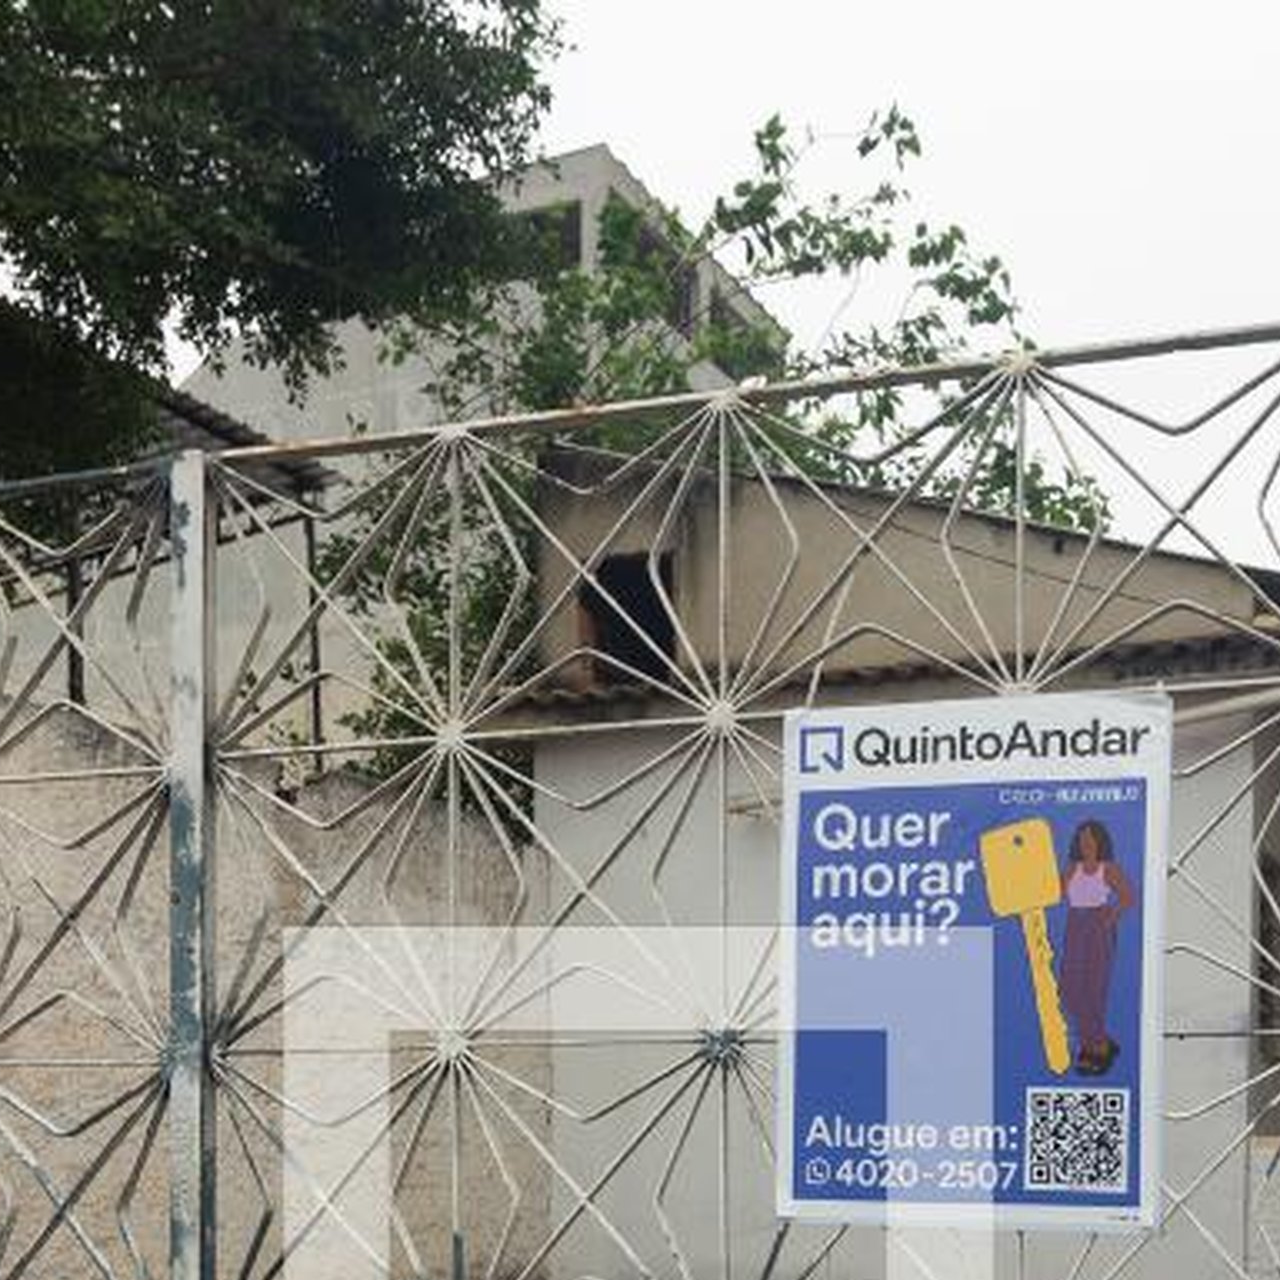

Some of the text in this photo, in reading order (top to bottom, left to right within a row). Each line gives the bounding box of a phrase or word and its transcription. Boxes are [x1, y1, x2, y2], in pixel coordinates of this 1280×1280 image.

[854, 718, 1150, 766] QuintoAndar
[814, 804, 950, 850] Quer
[812, 860, 975, 897] morar
[812, 900, 960, 955] aqui?
[805, 1116, 1018, 1156] Alugue em:
[835, 1160, 1018, 1189] 4020-2507
